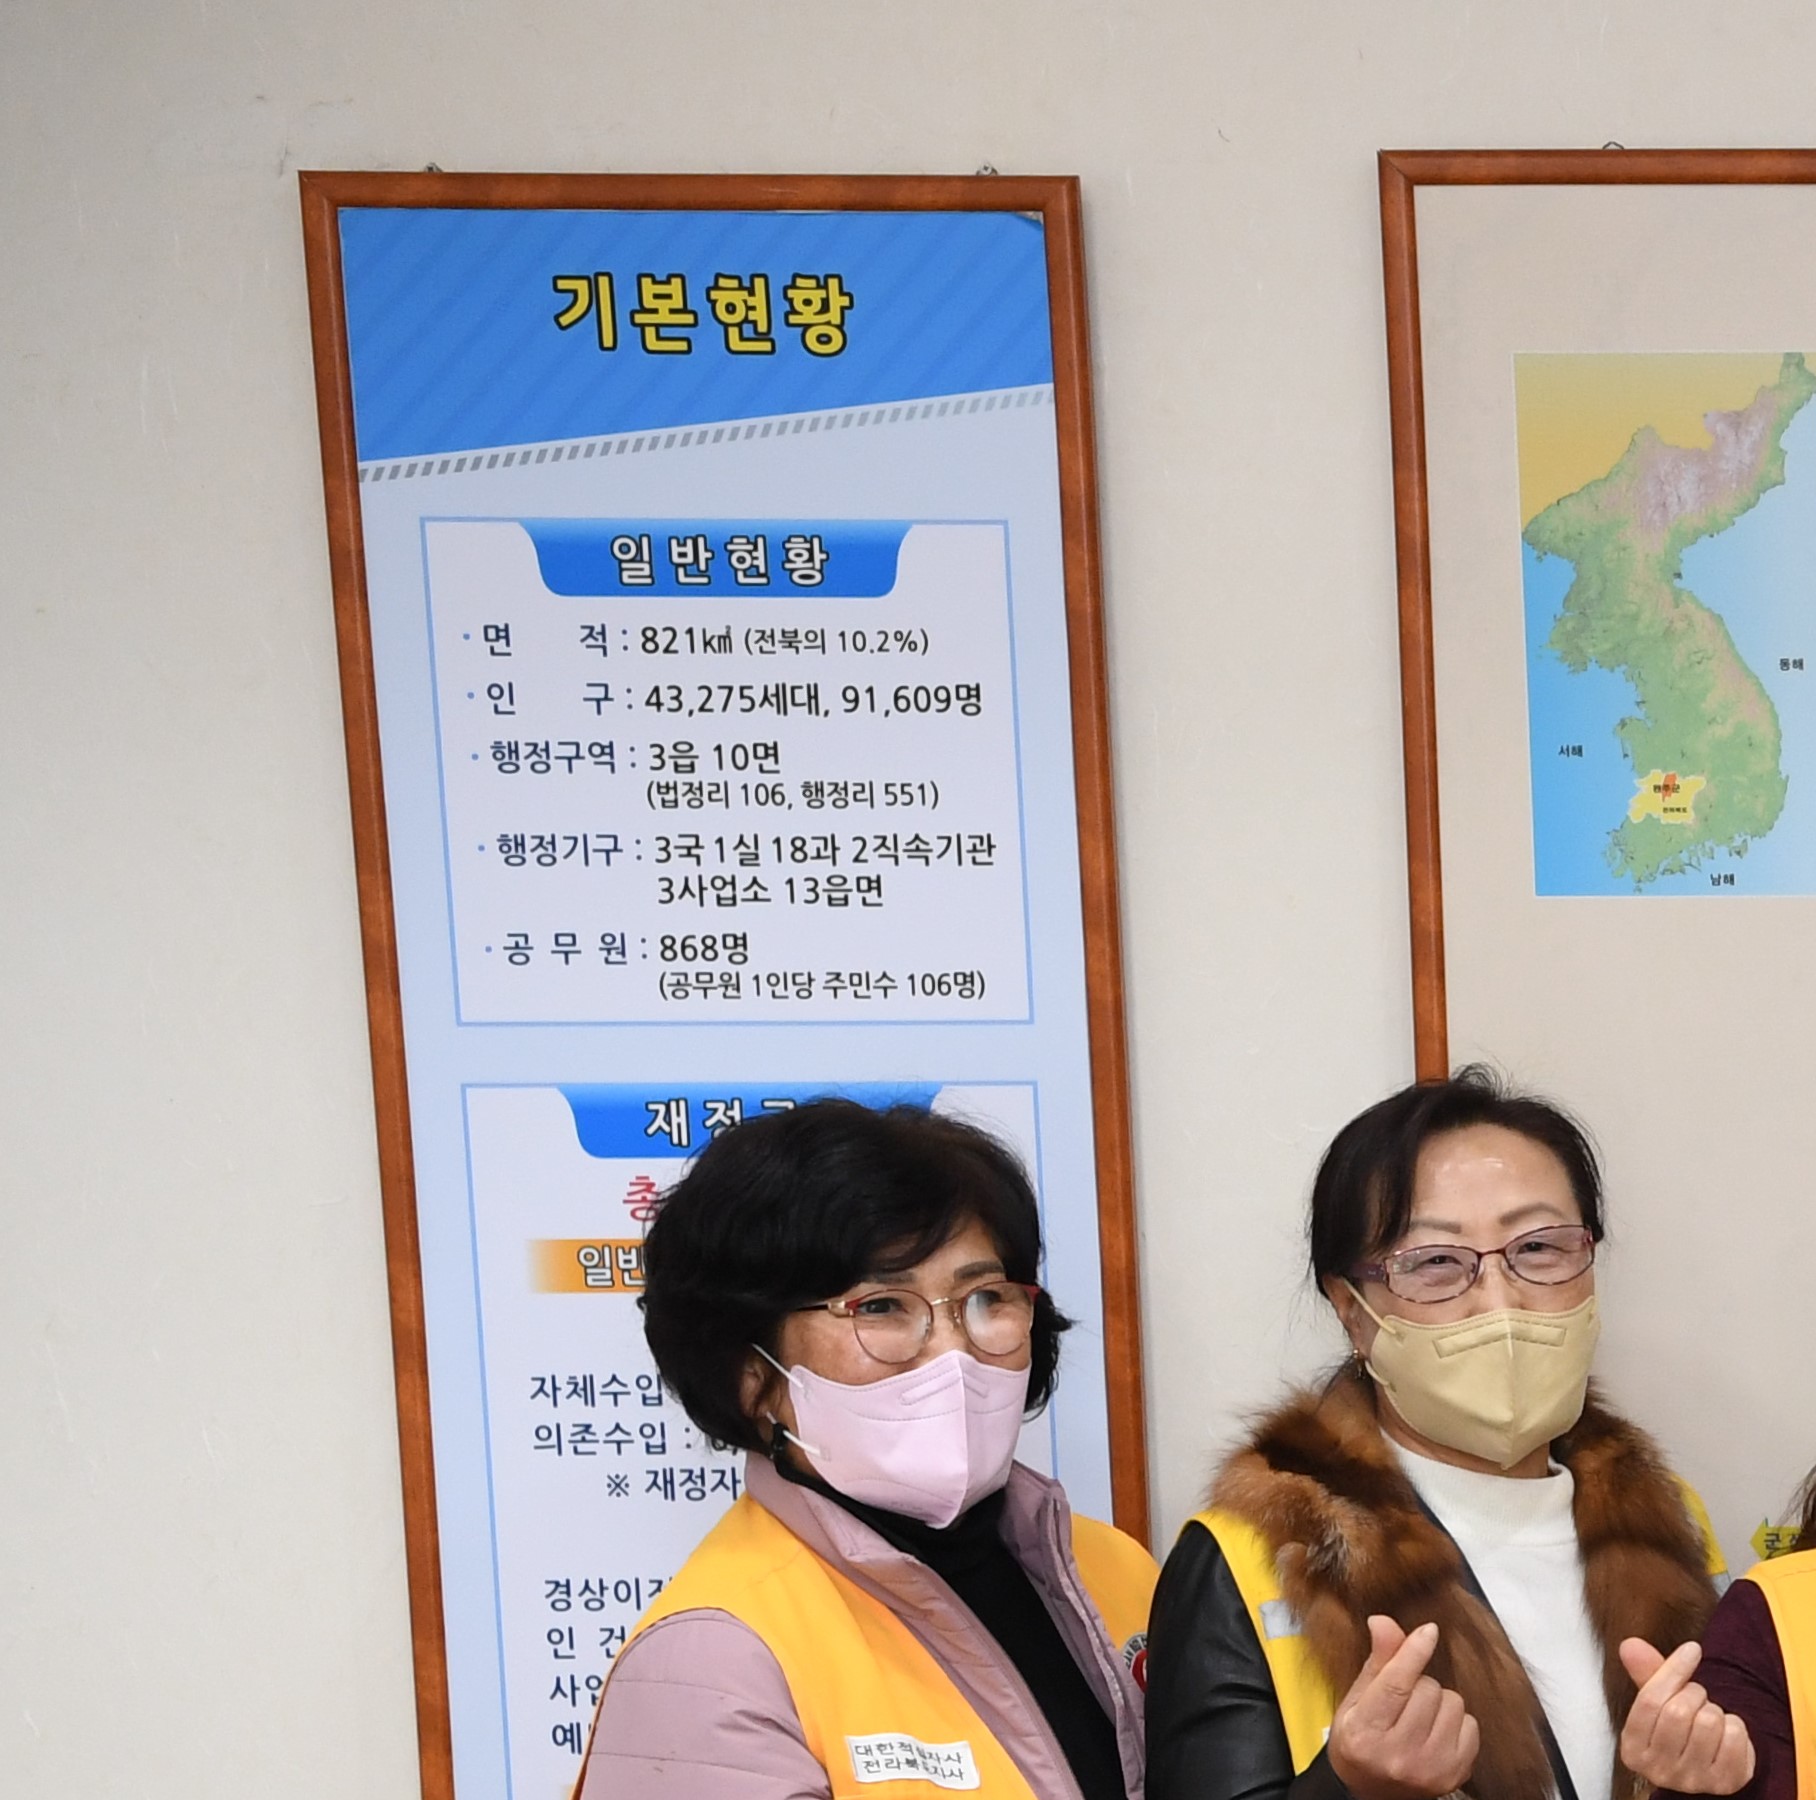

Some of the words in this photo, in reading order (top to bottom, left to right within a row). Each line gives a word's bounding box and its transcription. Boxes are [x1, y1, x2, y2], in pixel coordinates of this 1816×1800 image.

[553, 273, 854, 355] 기본현황
[610, 535, 829, 586] 일반현황
[744, 627, 826, 656] (전북의
[838, 628, 929, 656] 10.2%)
[1779, 657, 1804, 672] 동해
[644, 682, 830, 718] 43,275세대,
[841, 682, 982, 718] 91,609명
[489, 740, 616, 775] 행정구역
[649, 740, 700, 774] 3읍
[713, 740, 781, 775] 10면
[1558, 744, 1583, 758] 서해
[646, 780, 730, 810] (법정리
[740, 782, 793, 811] 106,
[800, 780, 875, 810] 행정리
[884, 780, 939, 810] 551)
[496, 833, 624, 867] 행정기구
[655, 833, 705, 867] 3국
[714, 833, 761, 867] 1실
[772, 833, 841, 867] 18과
[851, 832, 997, 867] 2직속기관
[658, 874, 772, 908] 3사업소
[784, 873, 884, 908] 13읍면
[1709, 873, 1735, 887] 남해
[660, 931, 749, 966] 868명
[659, 971, 742, 1001] (공무원
[752, 971, 816, 1000] 1인당
[822, 970, 899, 1000] 주민수
[907, 970, 986, 1000] 106명)
[530, 1374, 663, 1408] 자체수입
[533, 1421, 667, 1457] 의존수입
